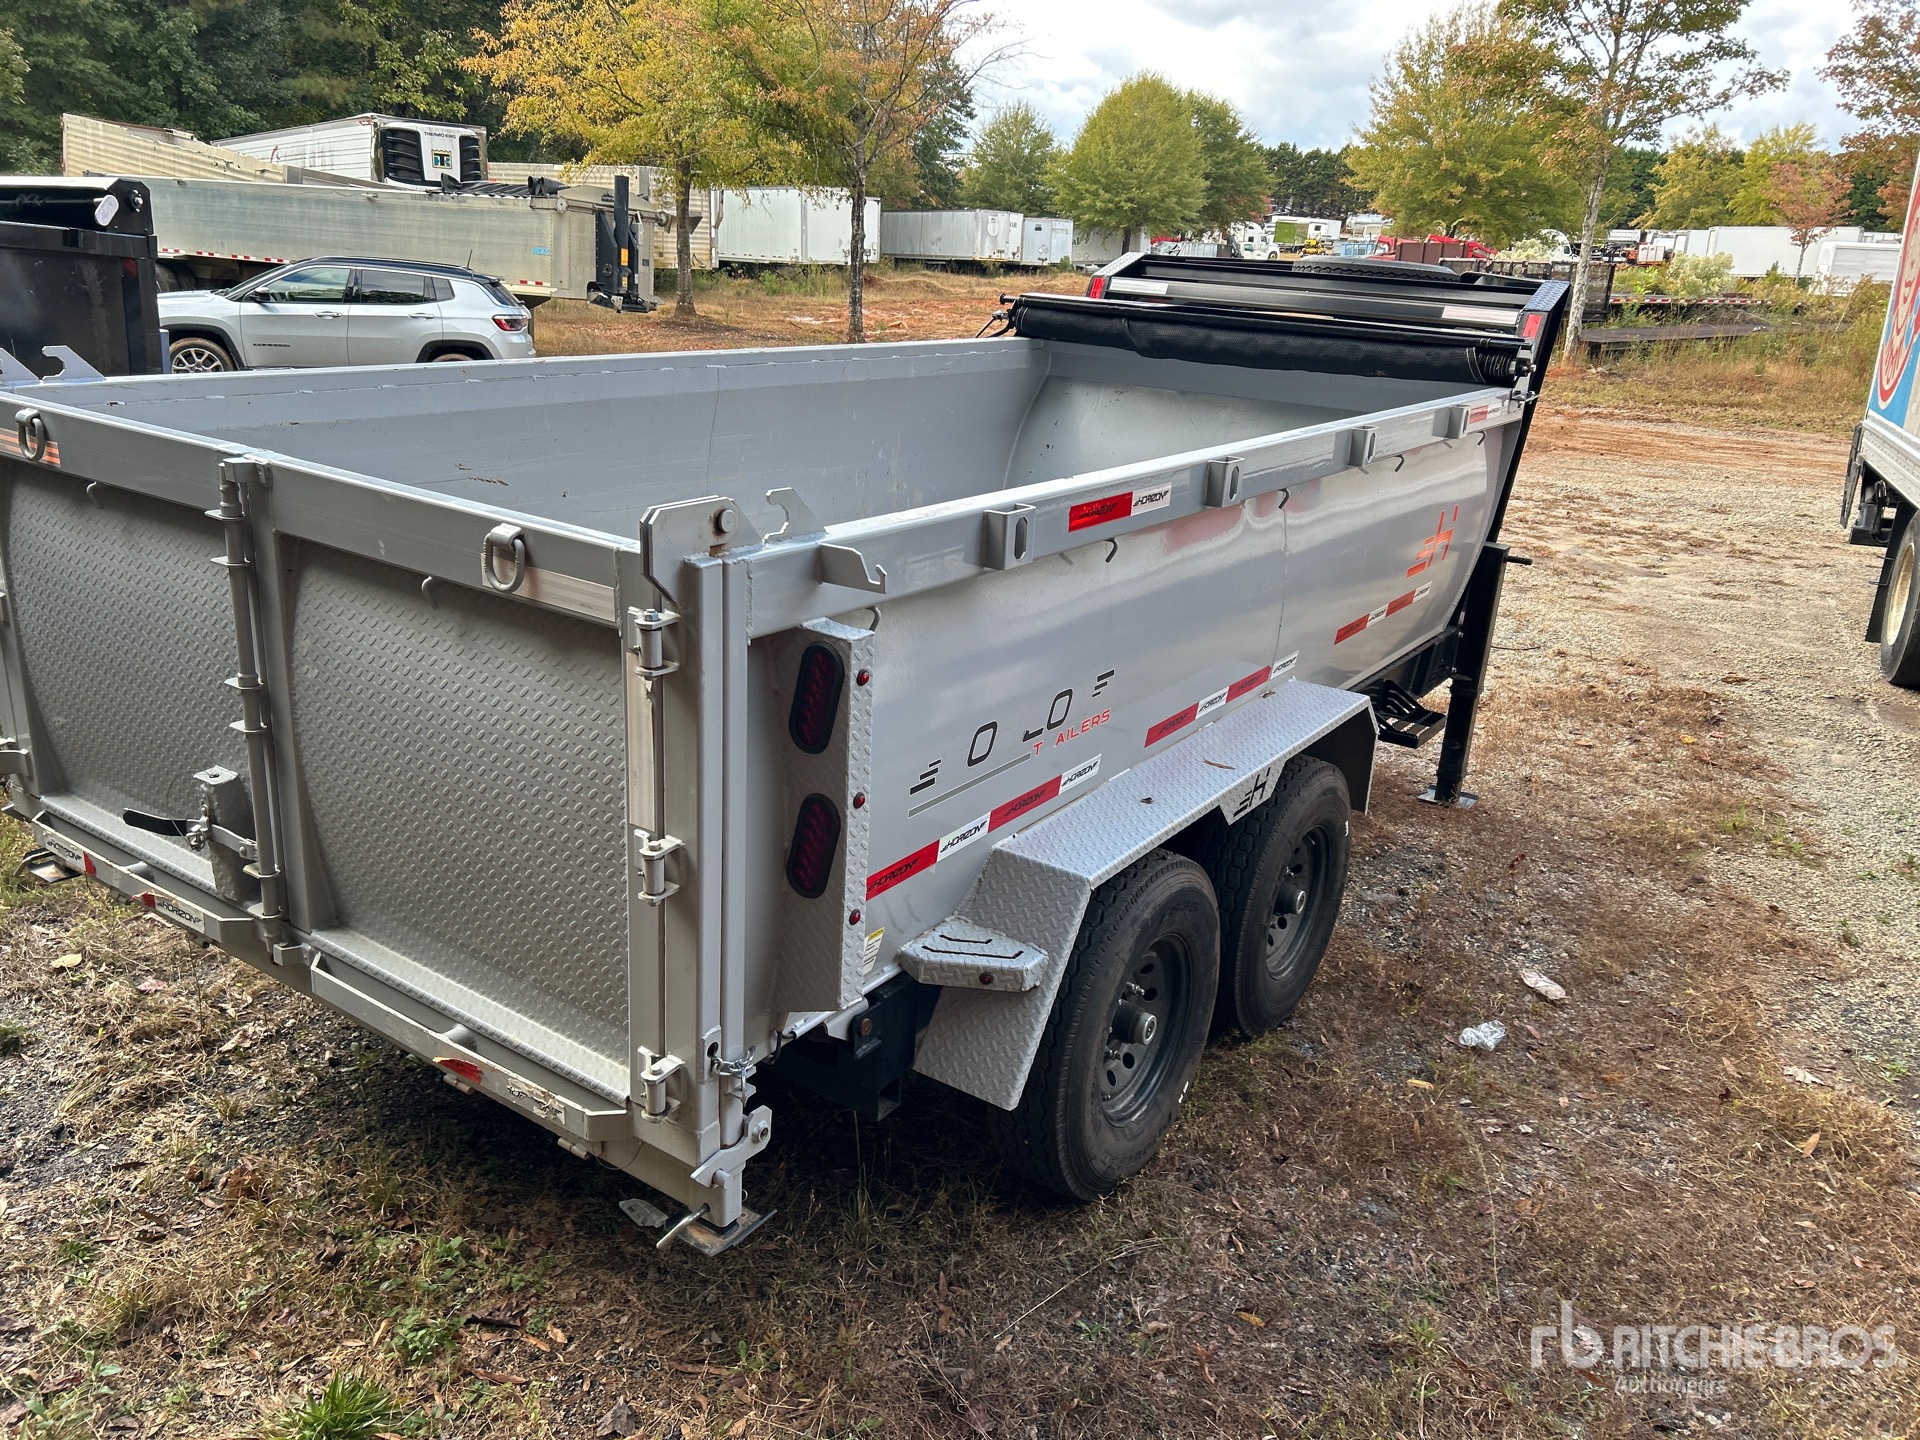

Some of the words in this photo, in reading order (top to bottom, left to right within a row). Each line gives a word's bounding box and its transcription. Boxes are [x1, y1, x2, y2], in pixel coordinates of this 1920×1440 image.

[1135, 491, 1166, 506] HORIZON
[1033, 709, 1111, 756] TAILERS
[944, 823, 984, 851] HORIZON
[1063, 762, 1096, 785] HORIZON
[161, 901, 199, 924] HORIZON
